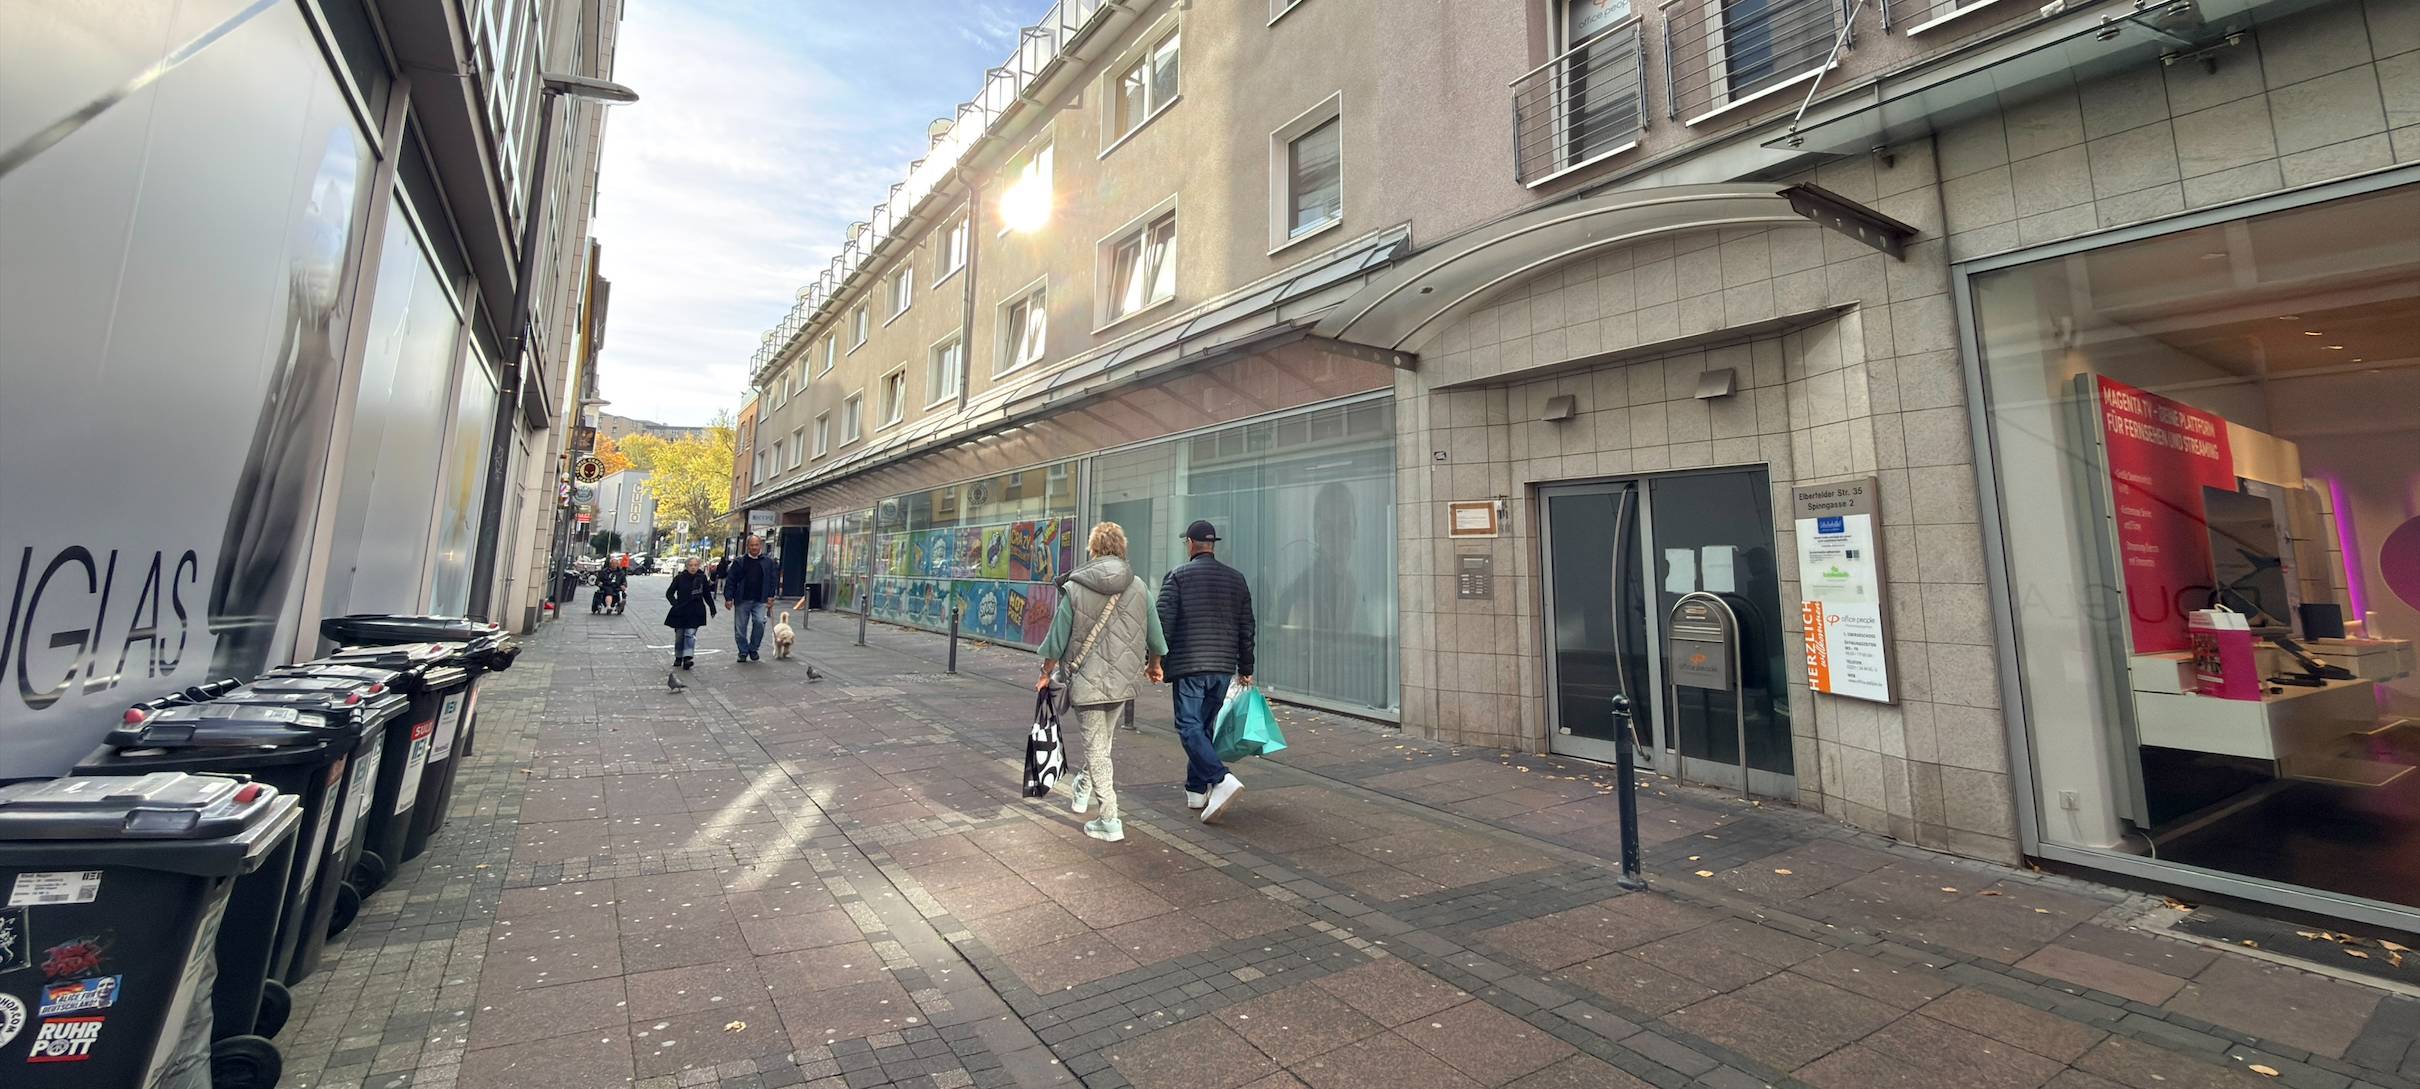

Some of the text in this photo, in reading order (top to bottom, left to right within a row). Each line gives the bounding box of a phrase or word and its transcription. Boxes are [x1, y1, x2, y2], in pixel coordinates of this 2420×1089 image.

[1604, 0, 1629, 19] peop
[2103, 388, 2144, 416] MAGENTA
[2179, 412, 2215, 438] PLATTFORM
[2106, 410, 2124, 435] FÜR
[2124, 417, 2167, 447] FERNSEHEN
[2183, 436, 2219, 461] STREAMING
[1799, 486, 1863, 500] Elberfelder Str. 35
[1808, 499, 1855, 511] Spinngasse 2
[1009, 591, 1025, 614] HOT
[1802, 600, 1820, 690] HERZLICH
[37, 1022, 103, 1040] RUHR
[29, 1038, 97, 1057] POTT
